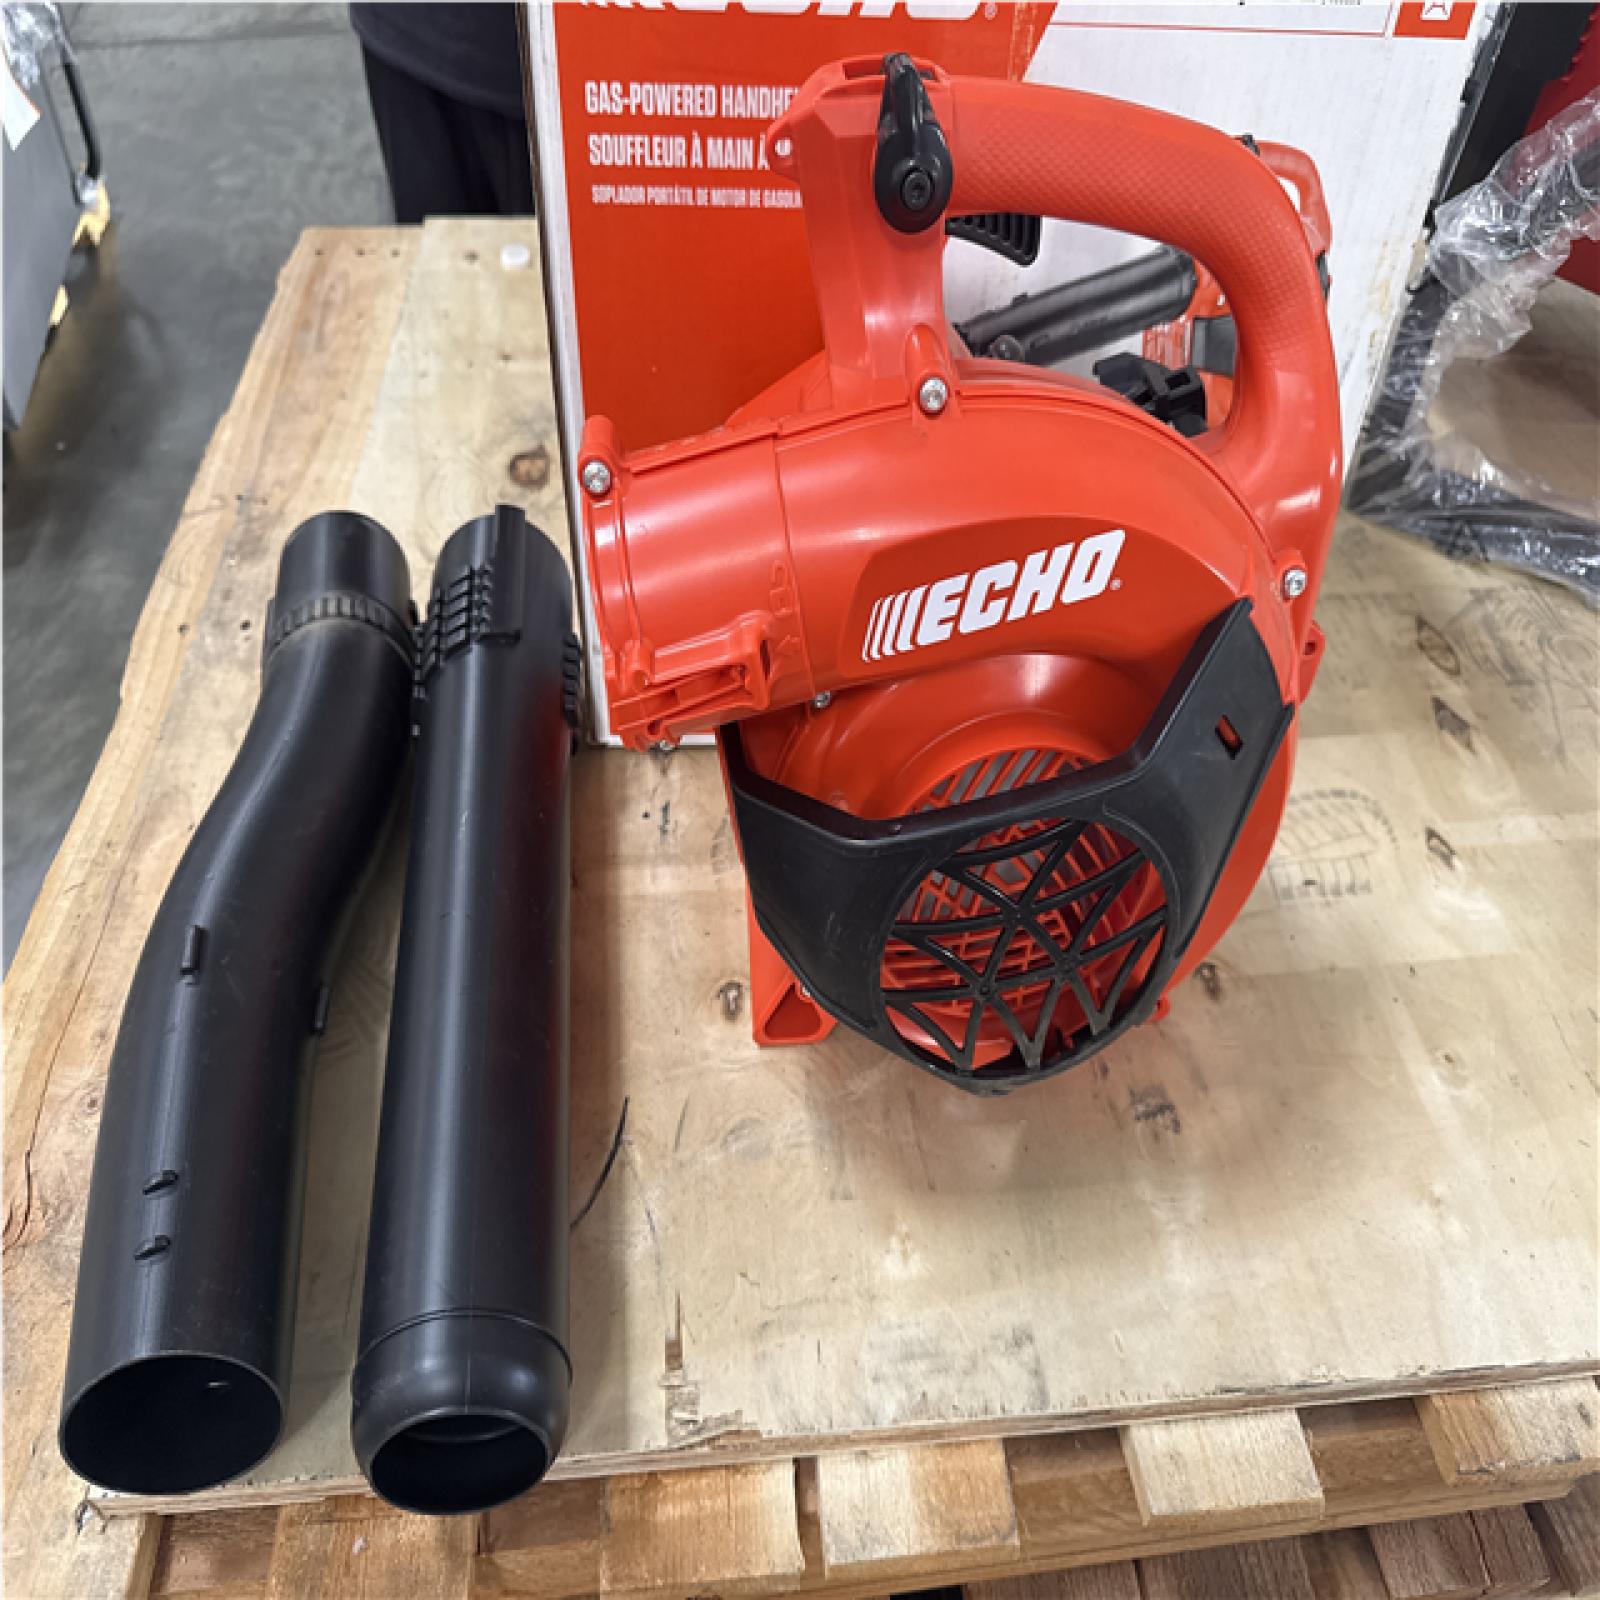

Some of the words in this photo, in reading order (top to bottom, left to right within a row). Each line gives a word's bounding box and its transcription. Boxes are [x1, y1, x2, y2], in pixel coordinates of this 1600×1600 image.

[584, 80, 717, 118] GAS-POWERED
[721, 85, 799, 119] HANDHE
[588, 132, 687, 168] SOUFFLEUR
[690, 129, 703, 168] À
[706, 135, 754, 170] MAIN
[591, 183, 646, 206] SOPLADOR
[696, 186, 709, 207] DE
[711, 187, 747, 208] MOTOR
[748, 188, 761, 208] DE
[915, 529, 1126, 647] ECHO
